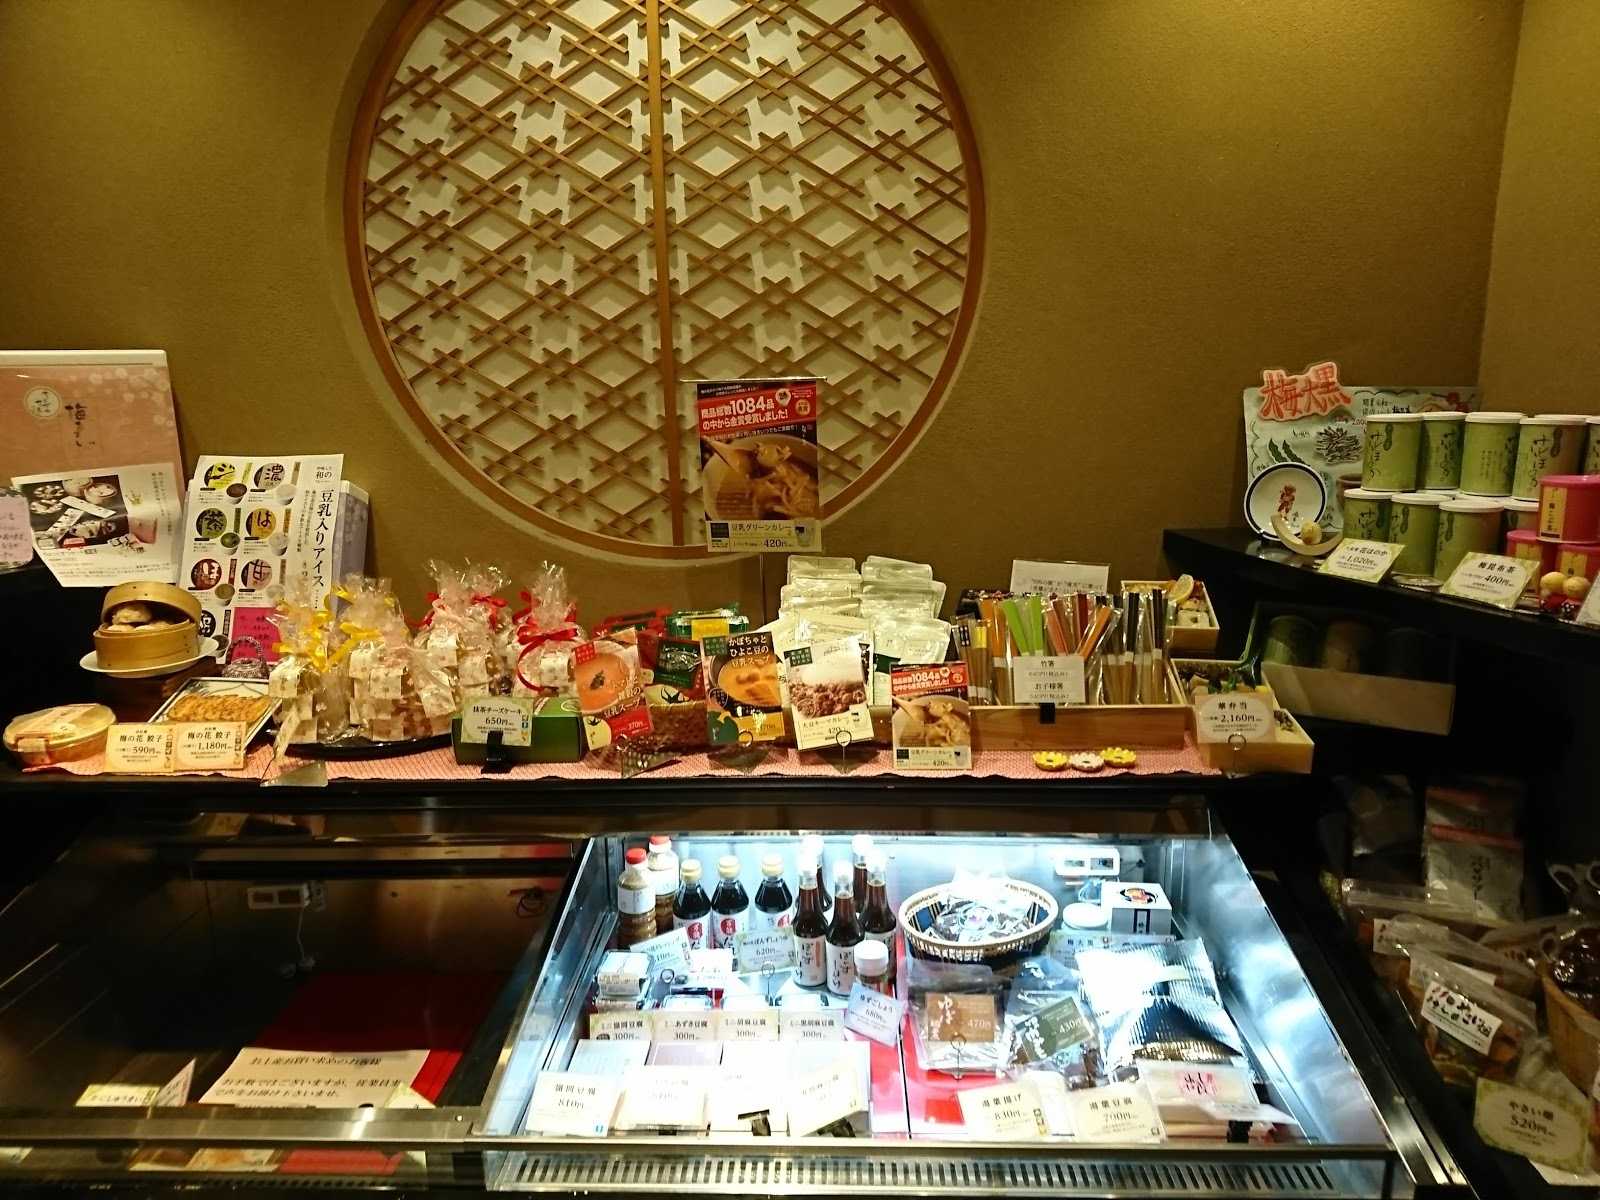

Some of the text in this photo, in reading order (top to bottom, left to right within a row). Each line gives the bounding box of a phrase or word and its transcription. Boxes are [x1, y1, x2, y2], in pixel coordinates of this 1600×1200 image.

[313, 489, 334, 587] 豆乳入りアイス
[729, 635, 767, 647] かぼちゃと
[730, 646, 769, 657] ひよこ豆の
